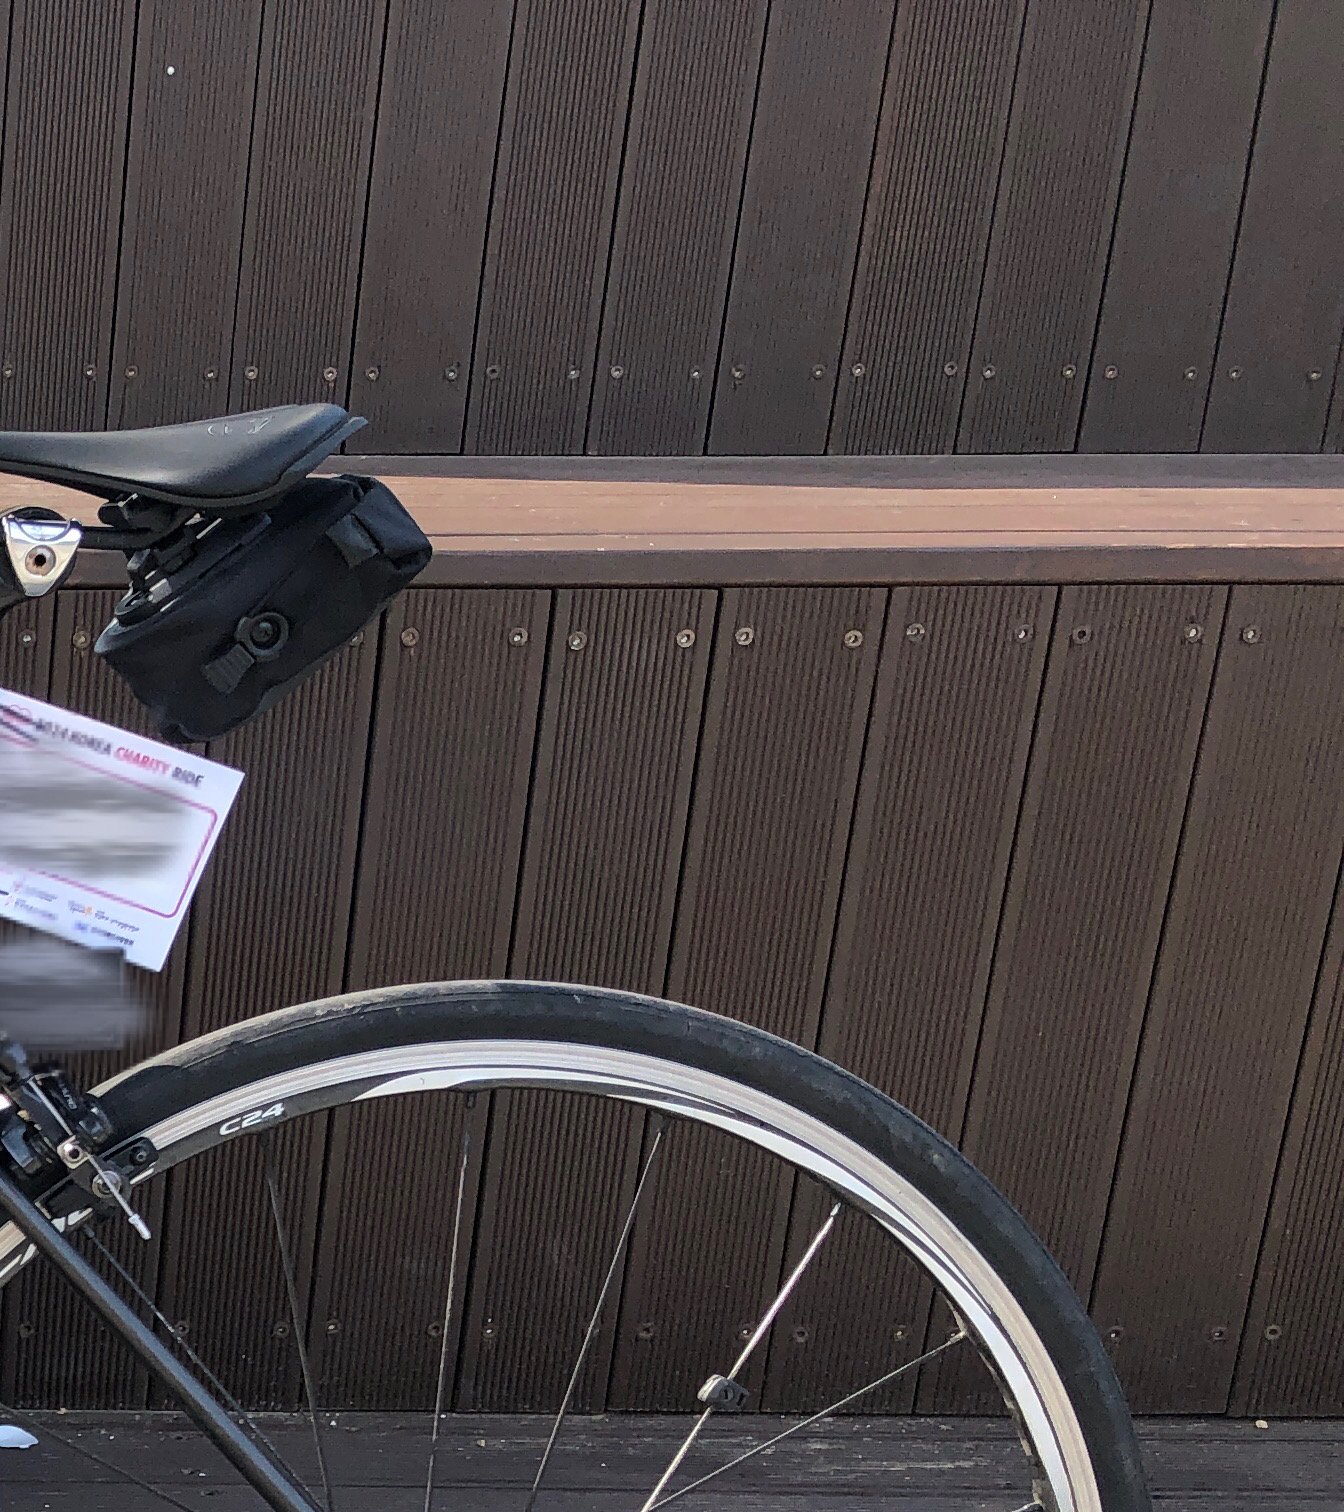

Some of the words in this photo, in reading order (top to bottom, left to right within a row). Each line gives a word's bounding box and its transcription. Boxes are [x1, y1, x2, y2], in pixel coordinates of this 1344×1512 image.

[113, 746, 172, 776] CHARITY
[171, 766, 205, 788] RIDE
[219, 1101, 286, 1138] C24
